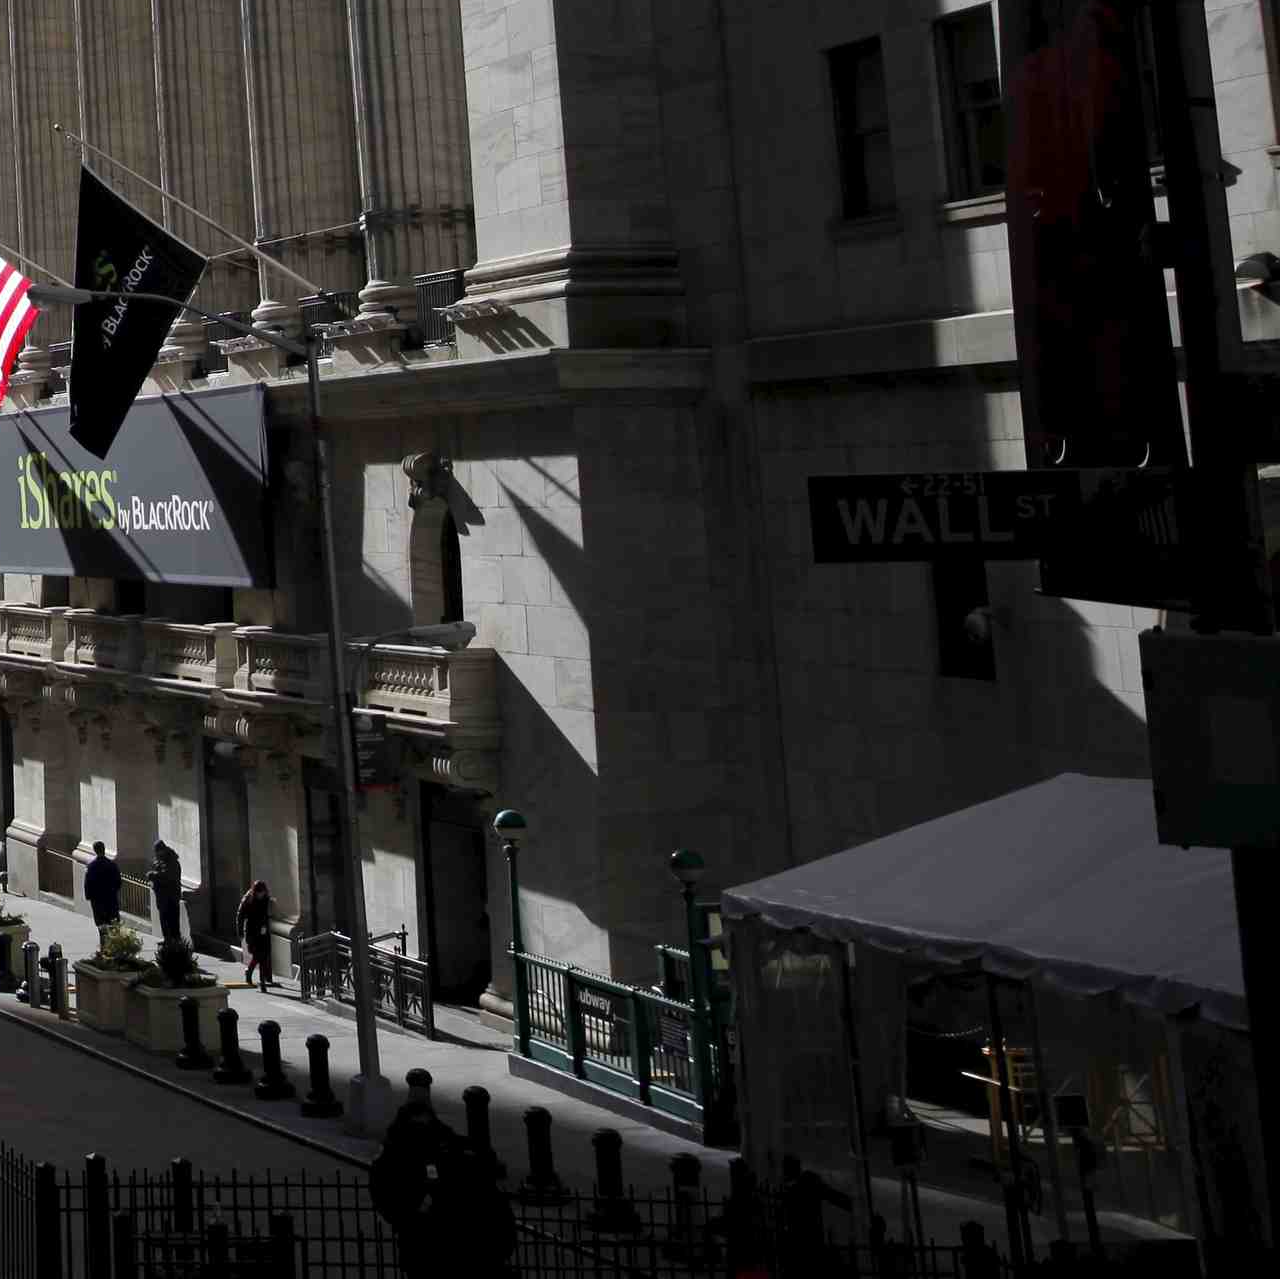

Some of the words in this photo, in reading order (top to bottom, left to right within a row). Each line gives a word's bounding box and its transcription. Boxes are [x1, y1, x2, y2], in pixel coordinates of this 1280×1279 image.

[17, 451, 116, 529] iShares
[117, 501, 131, 535] by
[131, 495, 211, 531] BLACKROCK
[834, 495, 1016, 545] WALL
[1015, 493, 1056, 521] ST
